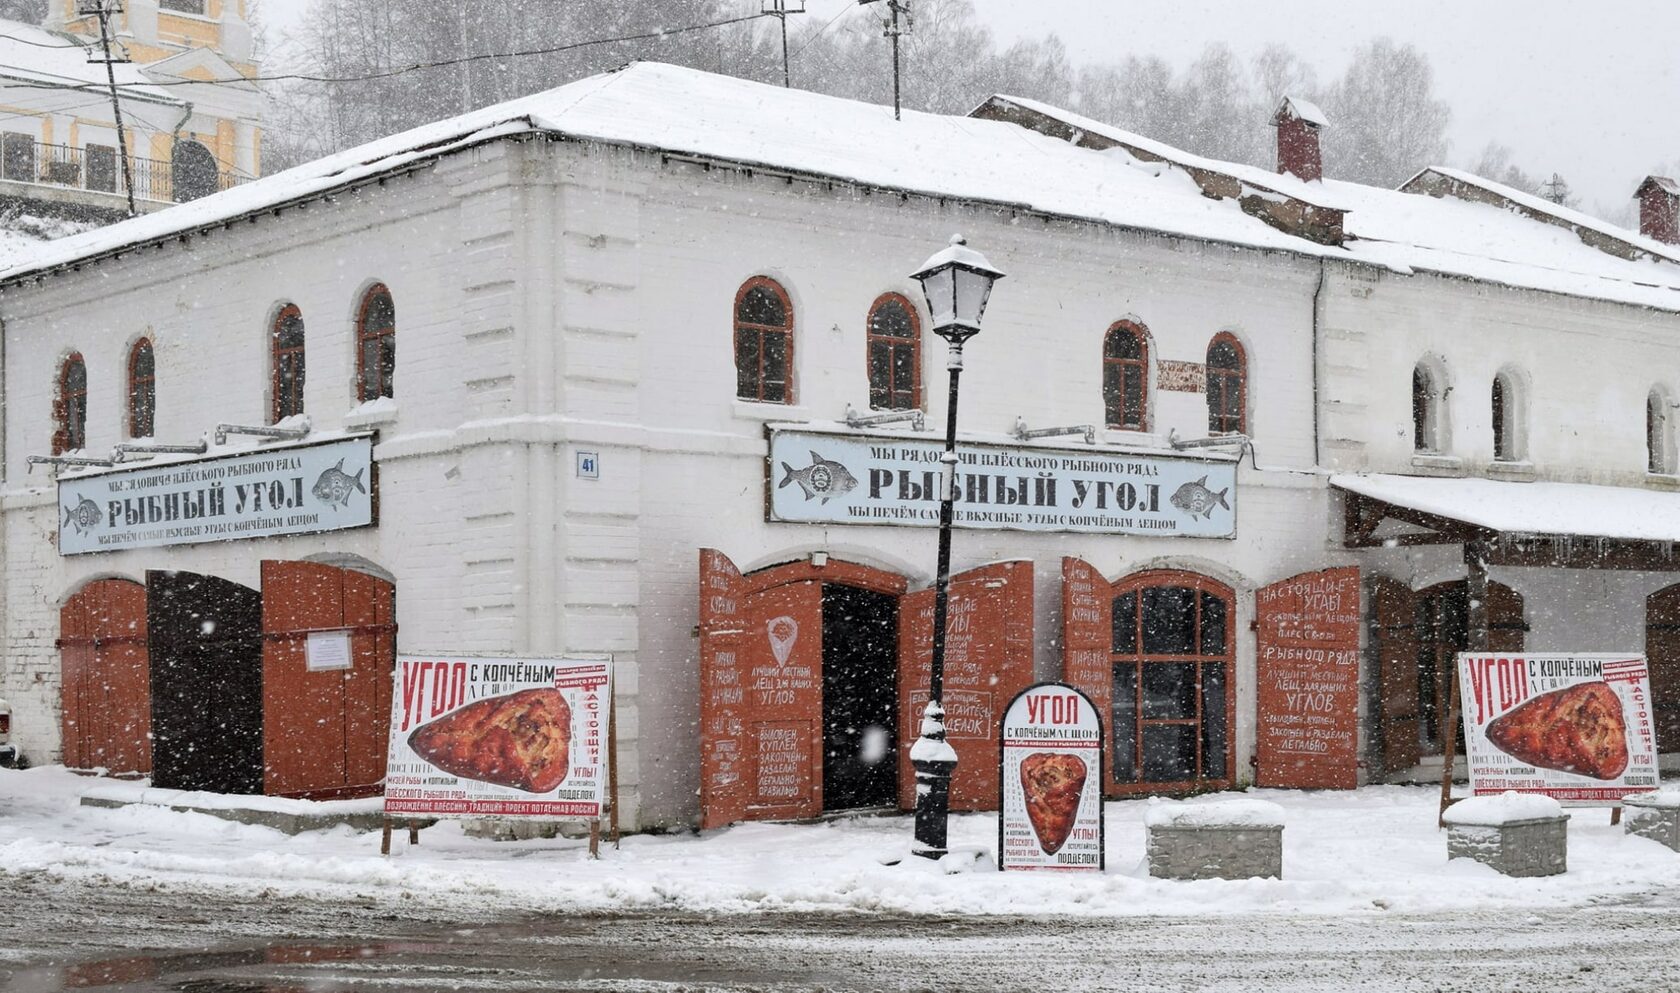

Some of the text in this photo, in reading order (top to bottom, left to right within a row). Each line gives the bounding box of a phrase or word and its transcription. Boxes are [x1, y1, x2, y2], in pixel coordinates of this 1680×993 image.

[582, 458, 594, 472] 41
[869, 446, 1159, 477] МЫ РЯДОЧИ ПЛЁССКОГО РЫБНОГО РЯДА
[108, 481, 123, 492] МЫ
[173, 467, 225, 485] ПЛЁССКОГО
[227, 460, 274, 478] РЫБНОГО
[276, 456, 302, 472] РЯДА
[108, 477, 304, 528] РЫБНЫЙ УГОЛ
[1071, 479, 1161, 513] УГОЛ
[847, 505, 1177, 532] МЫ ПЕЧЁМ САЕ ВКУСНЫЕ УГЛЫ С КОПЧЁНЫМ ЛЕЩОМ
[112, 530, 137, 544] ПЕЧЁМ
[165, 525, 201, 539] ВКУСНЫЕ
[204, 523, 227, 535] УГЛЫ
[234, 517, 283, 532] КОПЧЁНЫМ
[287, 513, 319, 530] ЛЕЩОМ
[1263, 578, 1346, 604] НАСТОЯЩИЕ
[920, 599, 978, 618] НАСЯЩИЕ
[1304, 594, 1341, 611] УГЛЫ
[1266, 647, 1325, 662] РЫБНОГО
[470, 661, 556, 683] С КОПЧЁНЫМ
[1529, 660, 1536, 677] С
[1540, 657, 1603, 678] КОПЧЁНЫМ
[556, 679, 588, 687] РЫБНОГО
[752, 678, 775, 691] ЛЕЩ
[1275, 678, 1300, 692] ЛЕЩ
[1468, 658, 1529, 725] УГОЛ
[401, 661, 467, 732] УГОЛ
[761, 689, 796, 706] УГЛОВ
[1286, 693, 1335, 713] УГЛОВ
[915, 703, 992, 720] ОРЕГАЙТЕСЬ
[1026, 695, 1079, 725] УГОЛ
[917, 718, 983, 737] ПДЕЛОК
[1007, 726, 1099, 740] С КОПЧЁНЫМ ЛЕЩОМ
[1281, 739, 1328, 752] ЛЕГАЛЬНО
[573, 767, 597, 778] УГЛЫ!
[558, 789, 596, 800] ПОДДЕЛОК!
[387, 801, 433, 811] ВОЗРОЖДЕНИЕ
[570, 803, 596, 815] РОССИЯ
[1073, 828, 1098, 840] УГЛЫ!
[1057, 852, 1098, 865] ПОДДЕЛОК!
